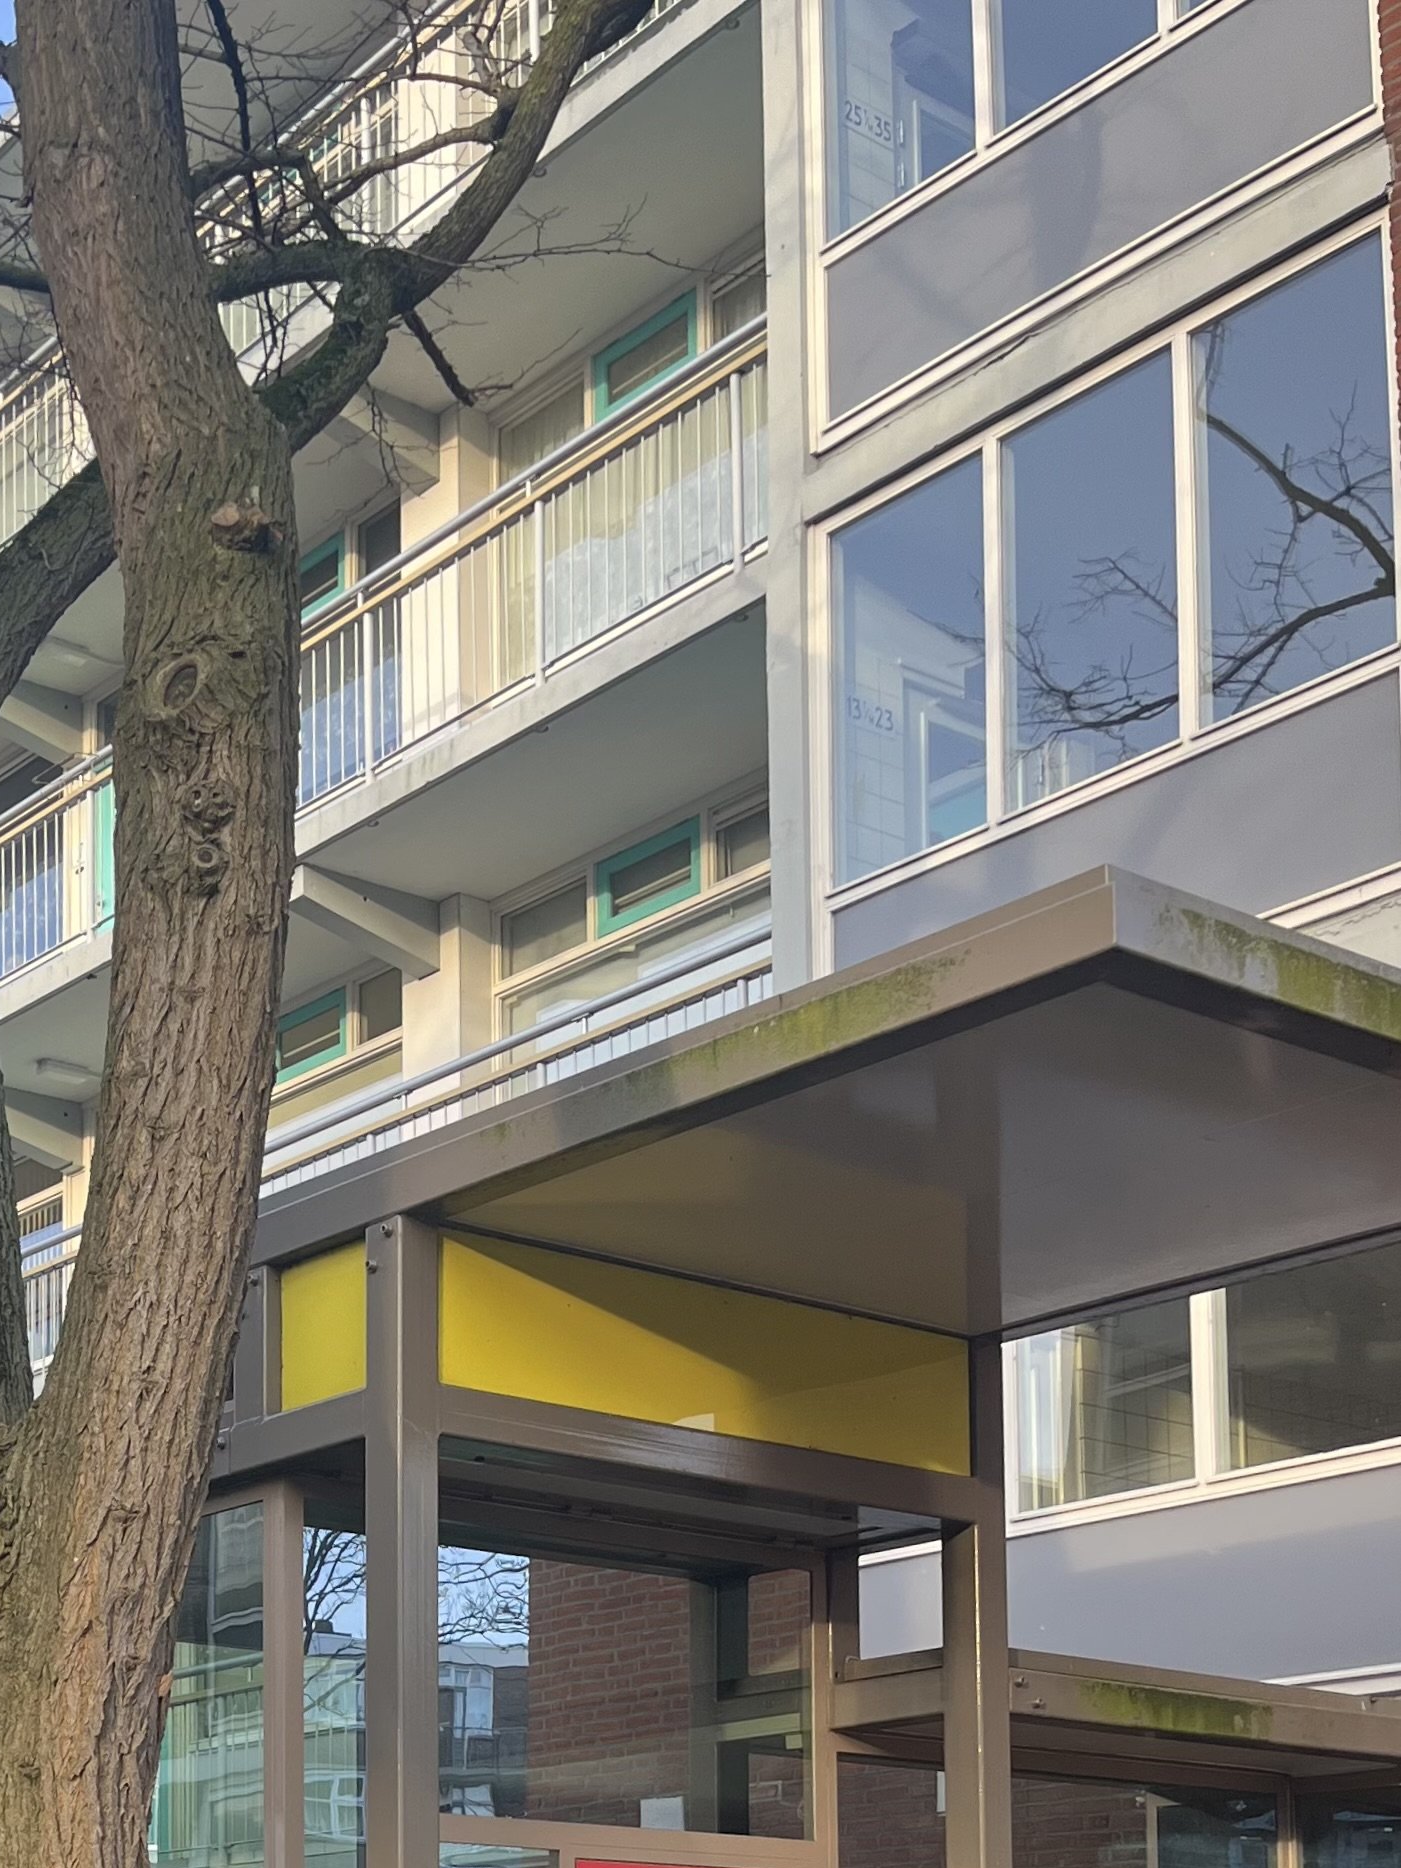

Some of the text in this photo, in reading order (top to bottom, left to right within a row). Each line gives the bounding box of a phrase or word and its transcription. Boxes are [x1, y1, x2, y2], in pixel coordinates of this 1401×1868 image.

[844, 99, 862, 126] 25
[874, 113, 891, 141] 35
[875, 705, 894, 731] 23
